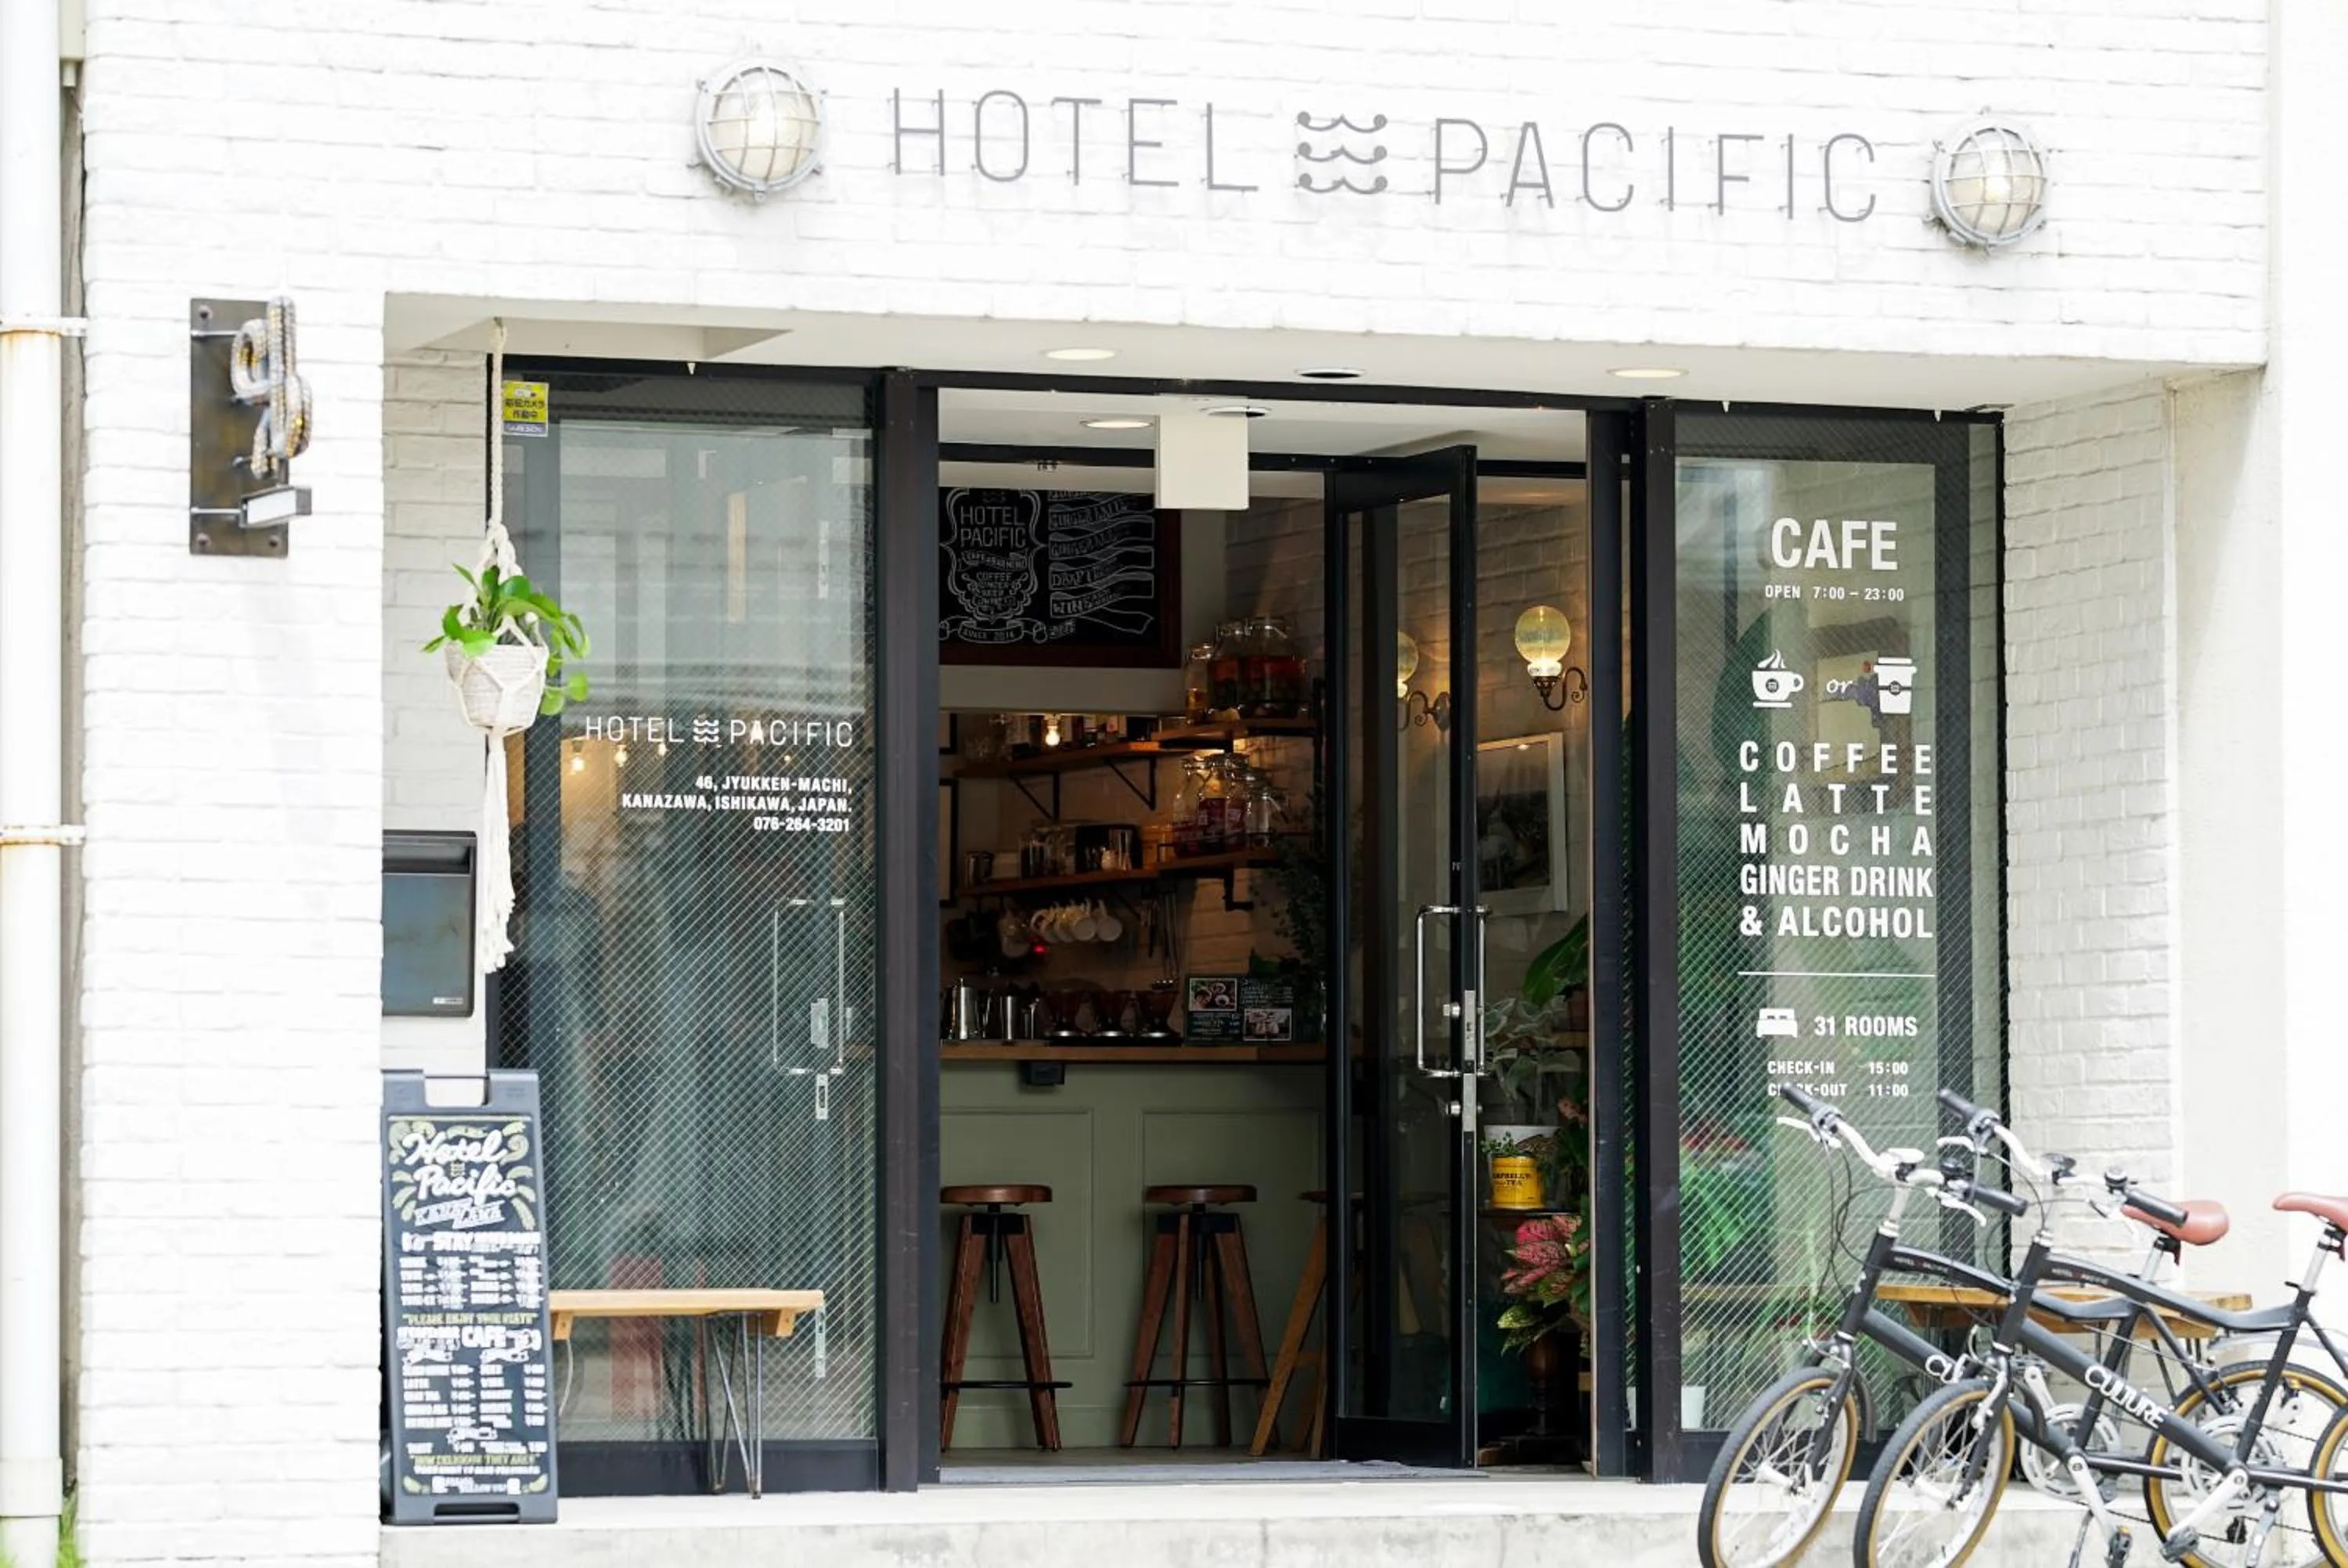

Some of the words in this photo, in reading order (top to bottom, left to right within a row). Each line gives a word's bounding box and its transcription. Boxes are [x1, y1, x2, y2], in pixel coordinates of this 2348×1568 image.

[893, 88, 1259, 192] HOTEL
[1433, 117, 1876, 222] PACIFIC
[960, 506, 1025, 525] HOTEL
[960, 527, 1026, 547] PACIFIC
[1771, 517, 1898, 570] CAFE
[1766, 584, 1800, 599] OPEN
[1813, 586, 1845, 599] 7:00
[1864, 588, 1904, 602] 23:00
[1826, 678, 1854, 694] or
[585, 716, 685, 743] HOTEL
[729, 719, 853, 747] PACIFIC
[1740, 741, 1932, 774] COFFEE
[695, 775, 718, 791] 46,
[722, 776, 852, 794] JYUKKEN-MACHI,
[622, 793, 711, 811] KANAZAWA,
[715, 796, 793, 812] ISHIKAWA,
[798, 797, 852, 812] JAPAN.
[1740, 782, 1932, 815] LATTE
[754, 817, 849, 832] 076-264-3201
[1740, 823, 1932, 856] MOCHA
[1740, 864, 1839, 896] GINGER
[1850, 866, 1934, 897] DRINK
[1740, 905, 1763, 937] &
[1777, 906, 1933, 938] ALCOHOL
[1813, 1016, 1835, 1037] 31
[1845, 1016, 1918, 1037] ROOMS
[1767, 1061, 1835, 1075] CHECK-IN
[1868, 1062, 1909, 1075] 15:00
[1868, 1084, 1909, 1097] 11:00
[402, 1130, 507, 1166] Hotel
[413, 1163, 517, 1205] Pacific
[462, 1325, 506, 1347] CAFE
[2084, 1365, 2168, 1429] CULTURE
